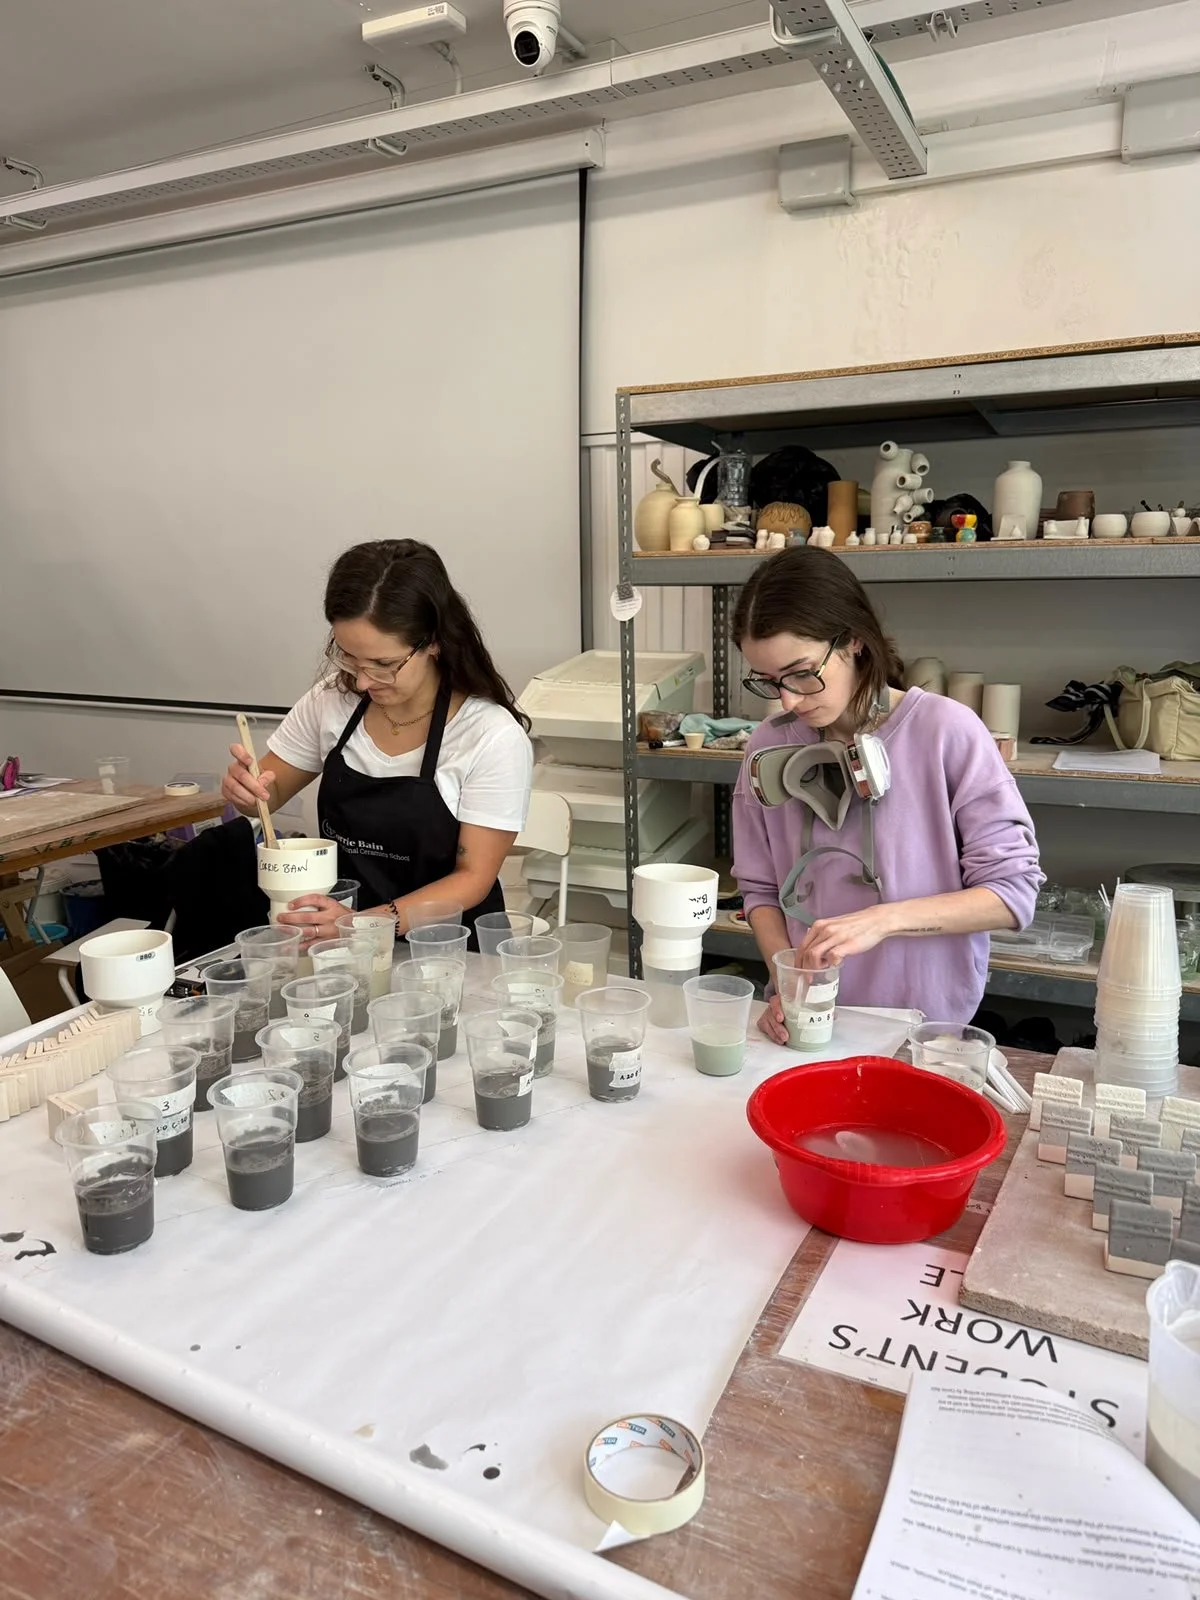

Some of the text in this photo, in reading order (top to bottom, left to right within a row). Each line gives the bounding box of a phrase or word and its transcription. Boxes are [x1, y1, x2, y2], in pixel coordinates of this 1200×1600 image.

[358, 840, 384, 851] Bain
[360, 849, 389, 859] Ceramics
[389, 852, 410, 861] School
[162, 1100, 170, 1112] 3
[900, 1299, 1058, 1364] WORK
[828, 1324, 1119, 1428] SENT'S
